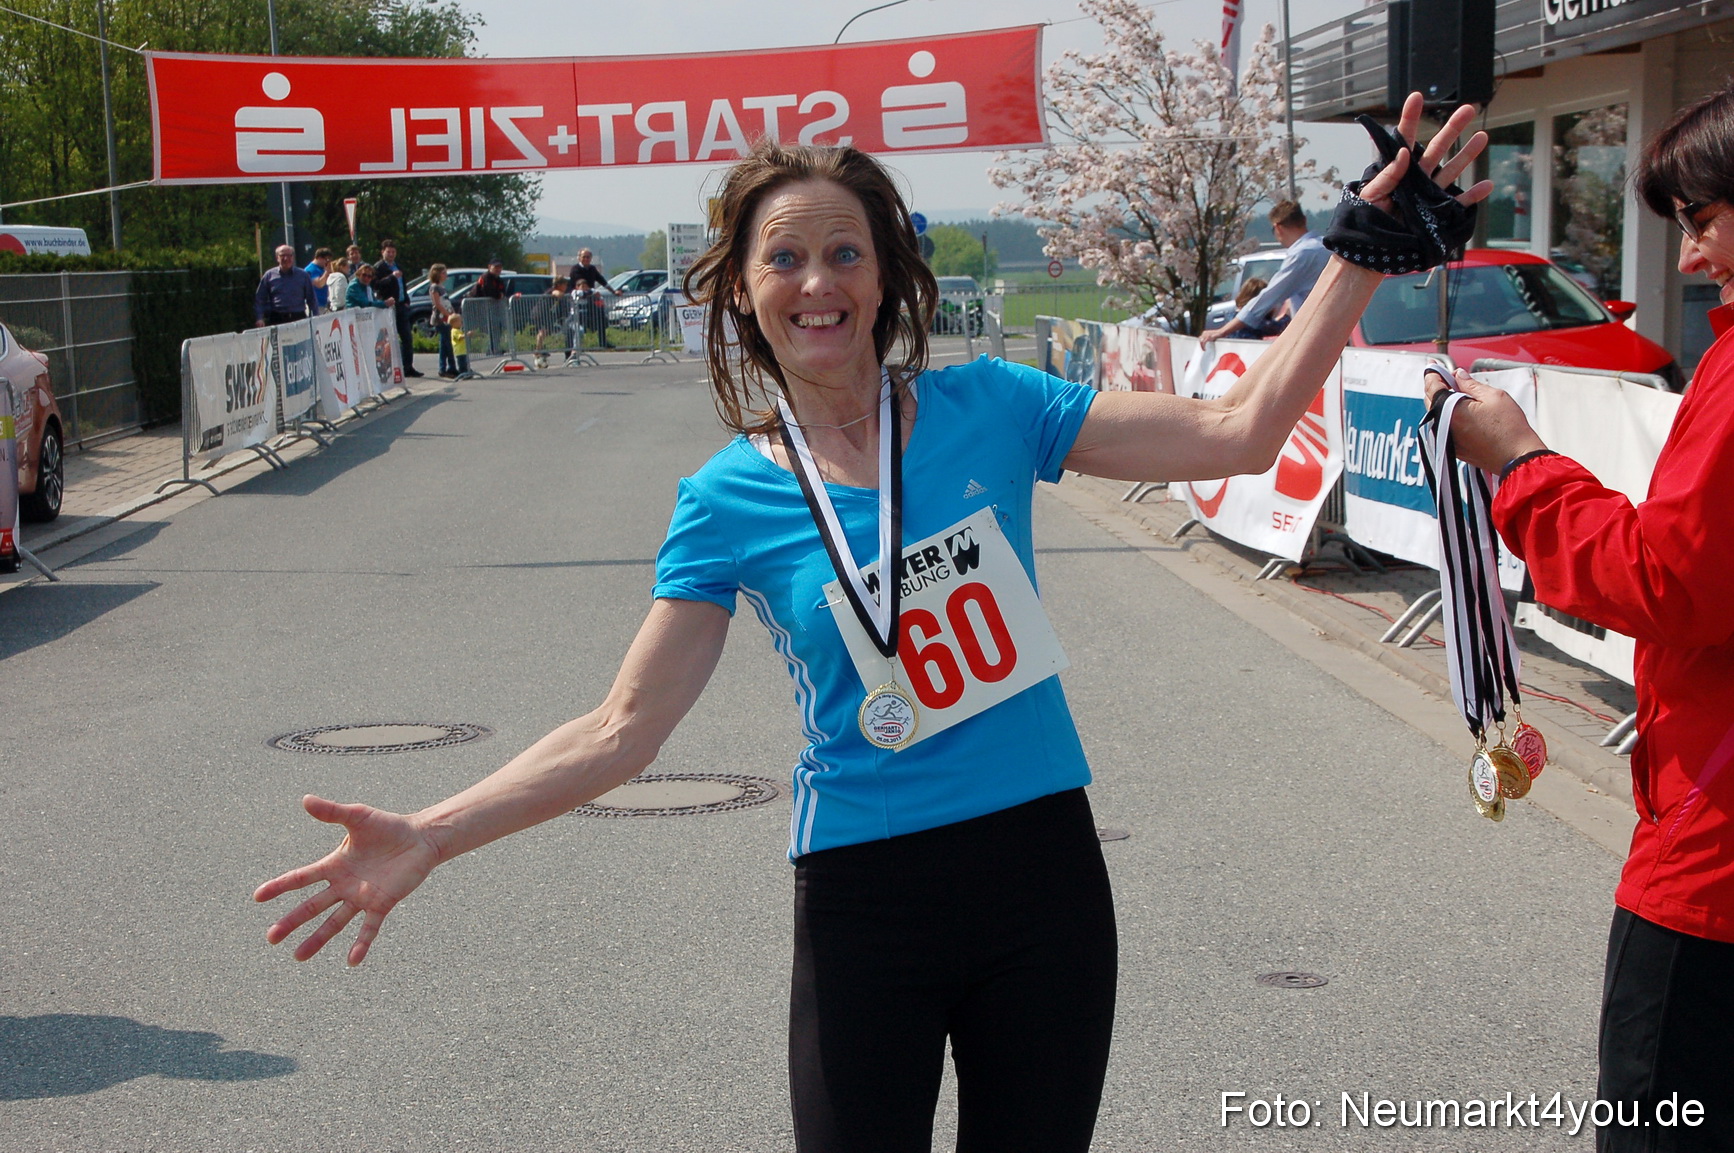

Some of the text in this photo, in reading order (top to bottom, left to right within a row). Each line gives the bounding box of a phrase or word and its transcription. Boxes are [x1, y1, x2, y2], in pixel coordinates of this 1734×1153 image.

[25, 238, 86, 247] www.buchbinder.de
[963, 486, 989, 499] adidas
[861, 545, 945, 595] MYER
[897, 581, 1018, 710] 60
